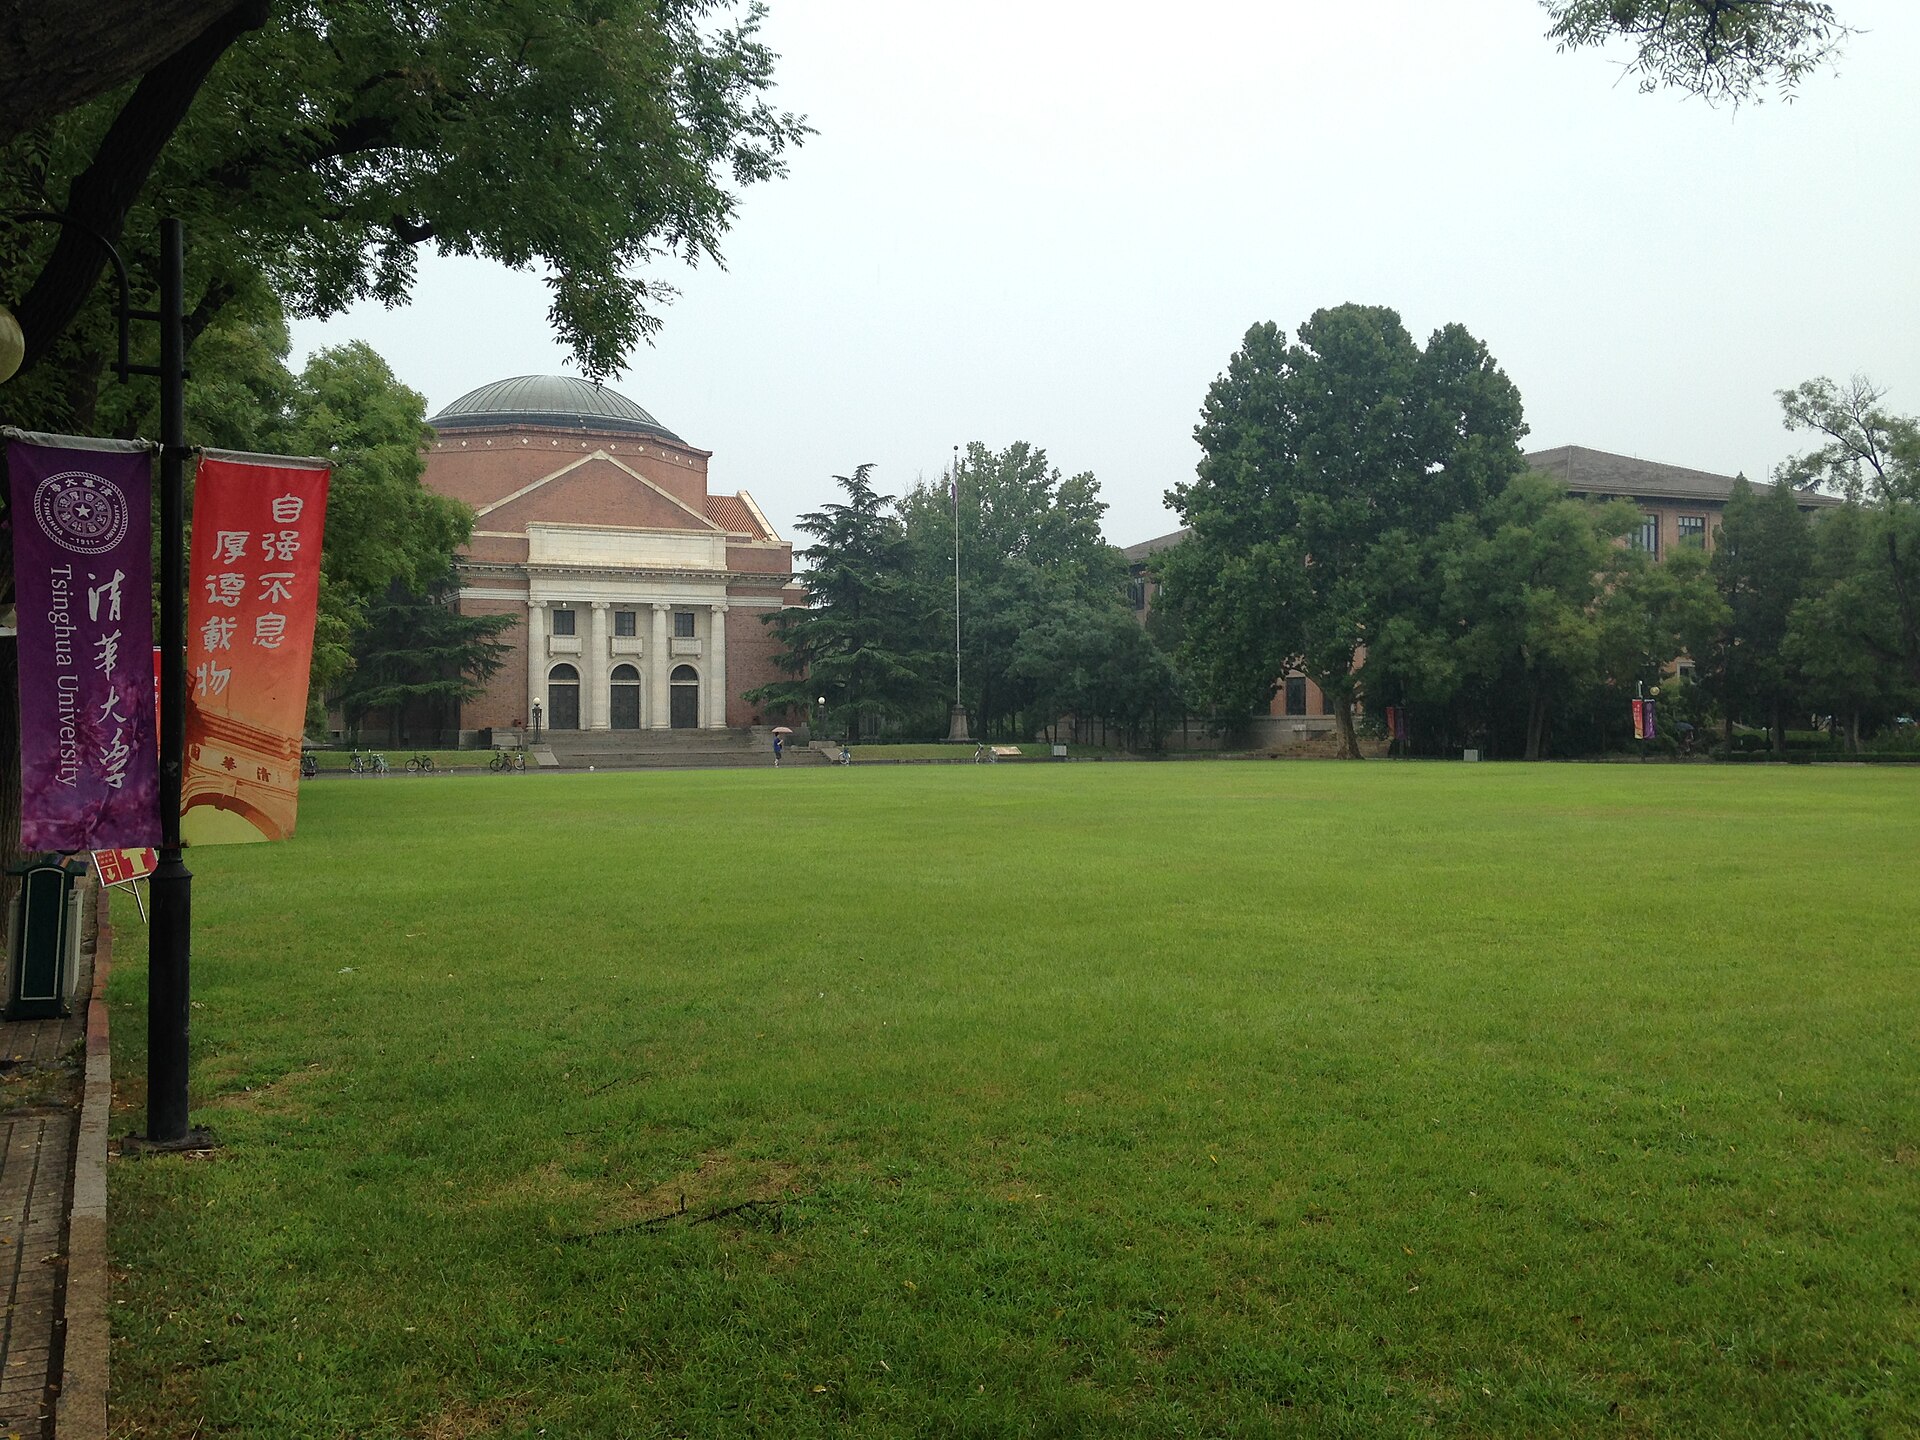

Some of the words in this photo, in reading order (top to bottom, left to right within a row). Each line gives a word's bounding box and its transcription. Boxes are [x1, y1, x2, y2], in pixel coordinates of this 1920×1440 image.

[43, 497, 64, 536] TSINGHUA
[103, 504, 121, 541] UNIVERSITY
[48, 564, 77, 667] Tsinghua
[55, 674, 83, 788] University
